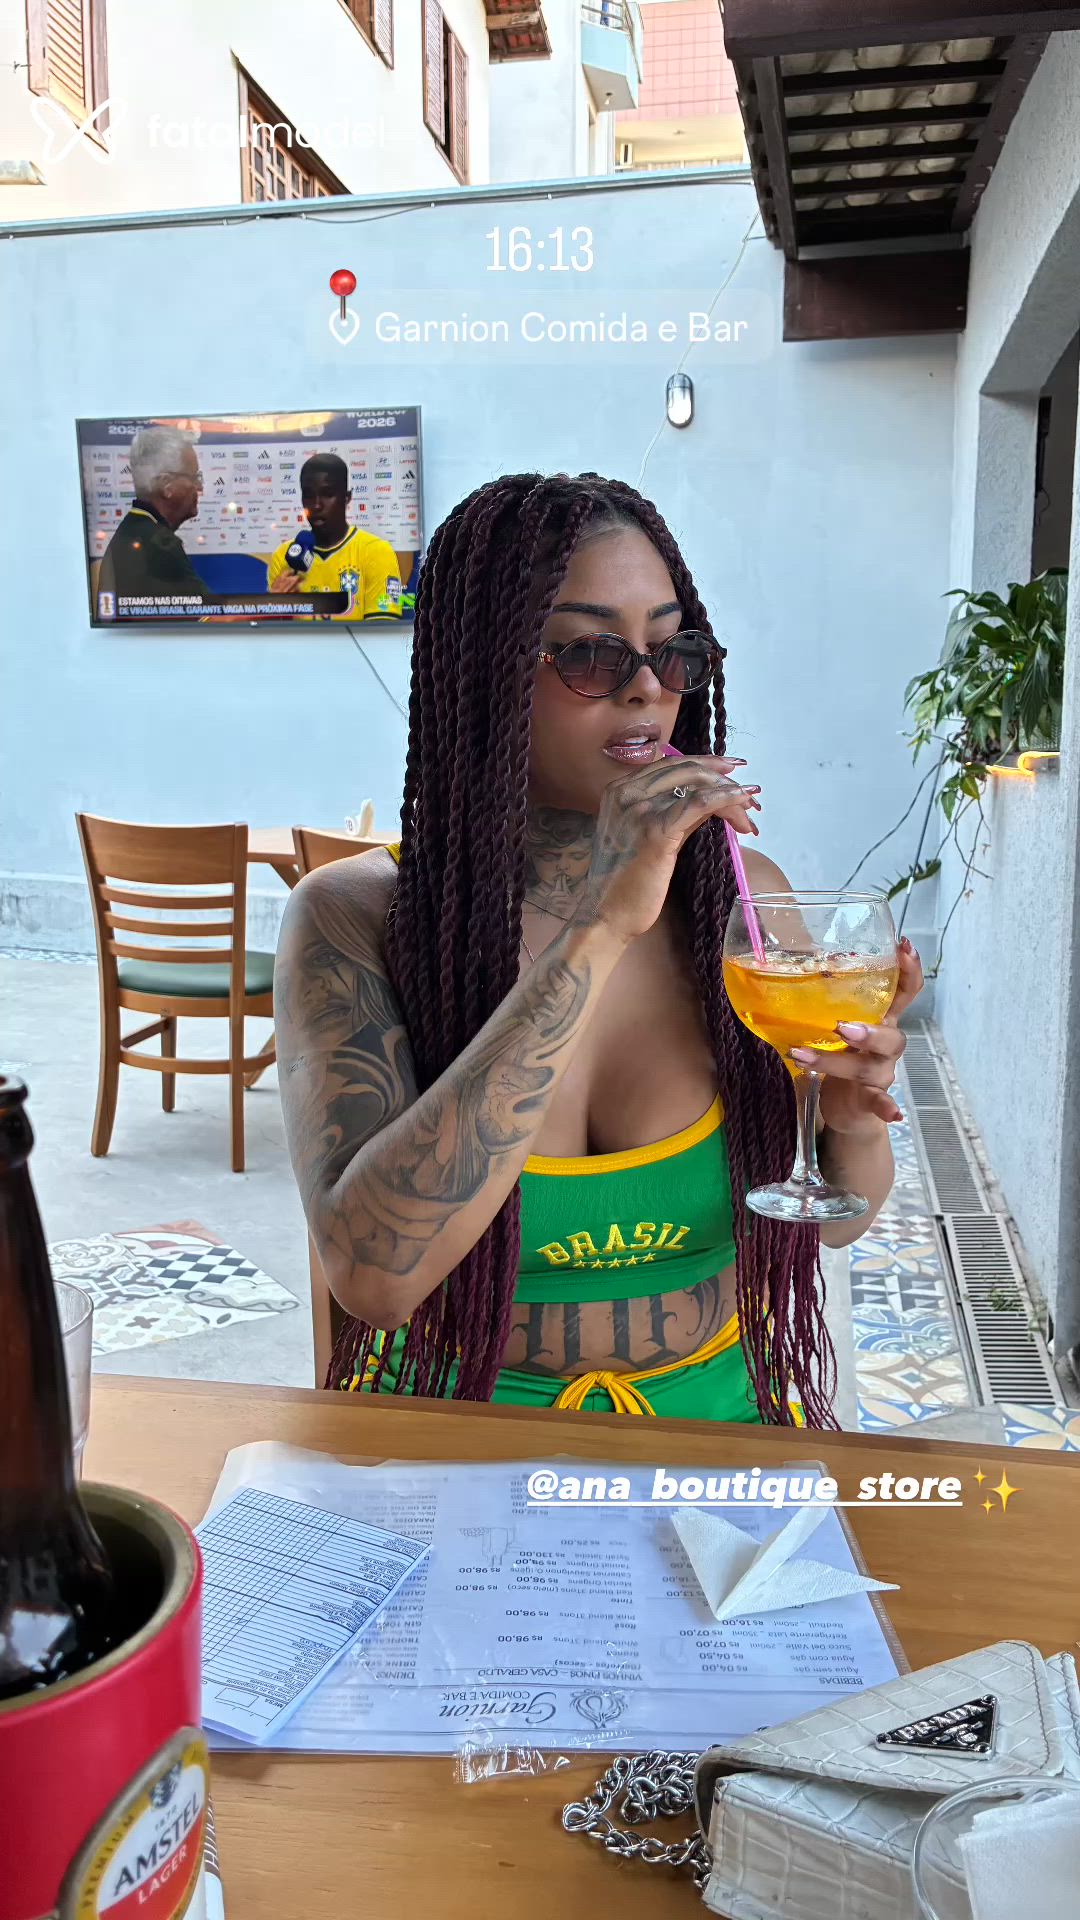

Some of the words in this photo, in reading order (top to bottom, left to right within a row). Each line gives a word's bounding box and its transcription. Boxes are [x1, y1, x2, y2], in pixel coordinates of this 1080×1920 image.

[357, 417, 396, 428] 2026
[118, 596, 153, 606] ESTAMOS
[155, 596, 170, 605] NAS
[171, 596, 202, 605] OITAVAS
[119, 607, 129, 615] DE
[130, 606, 158, 615] VIRADA
[159, 606, 185, 614] BRASIL
[186, 605, 222, 614] GARANTE
[223, 604, 244, 613] VAGA
[245, 604, 256, 613] NA
[294, 603, 314, 612] FASE
[536, 1222, 690, 1265] BRASIL
[695, 1640, 726, 1648] 07,00
[699, 1652, 730, 1660] 04,50
[702, 1664, 734, 1672] 04,00
[477, 1669, 528, 1677] GERALDO
[603, 1673, 642, 1681] VINHOS
[819, 1677, 863, 1685] BEBIDAS
[441, 1692, 466, 1700] BAR
[469, 1692, 476, 1700] E
[481, 1691, 530, 1699] COMIDA
[262, 1698, 284, 1707] MESA
[439, 1692, 556, 1724] Garnion
[895, 1703, 985, 1740] PRADA
[113, 1792, 199, 1896] AMSTEL
[137, 1845, 188, 1905] LAGER
